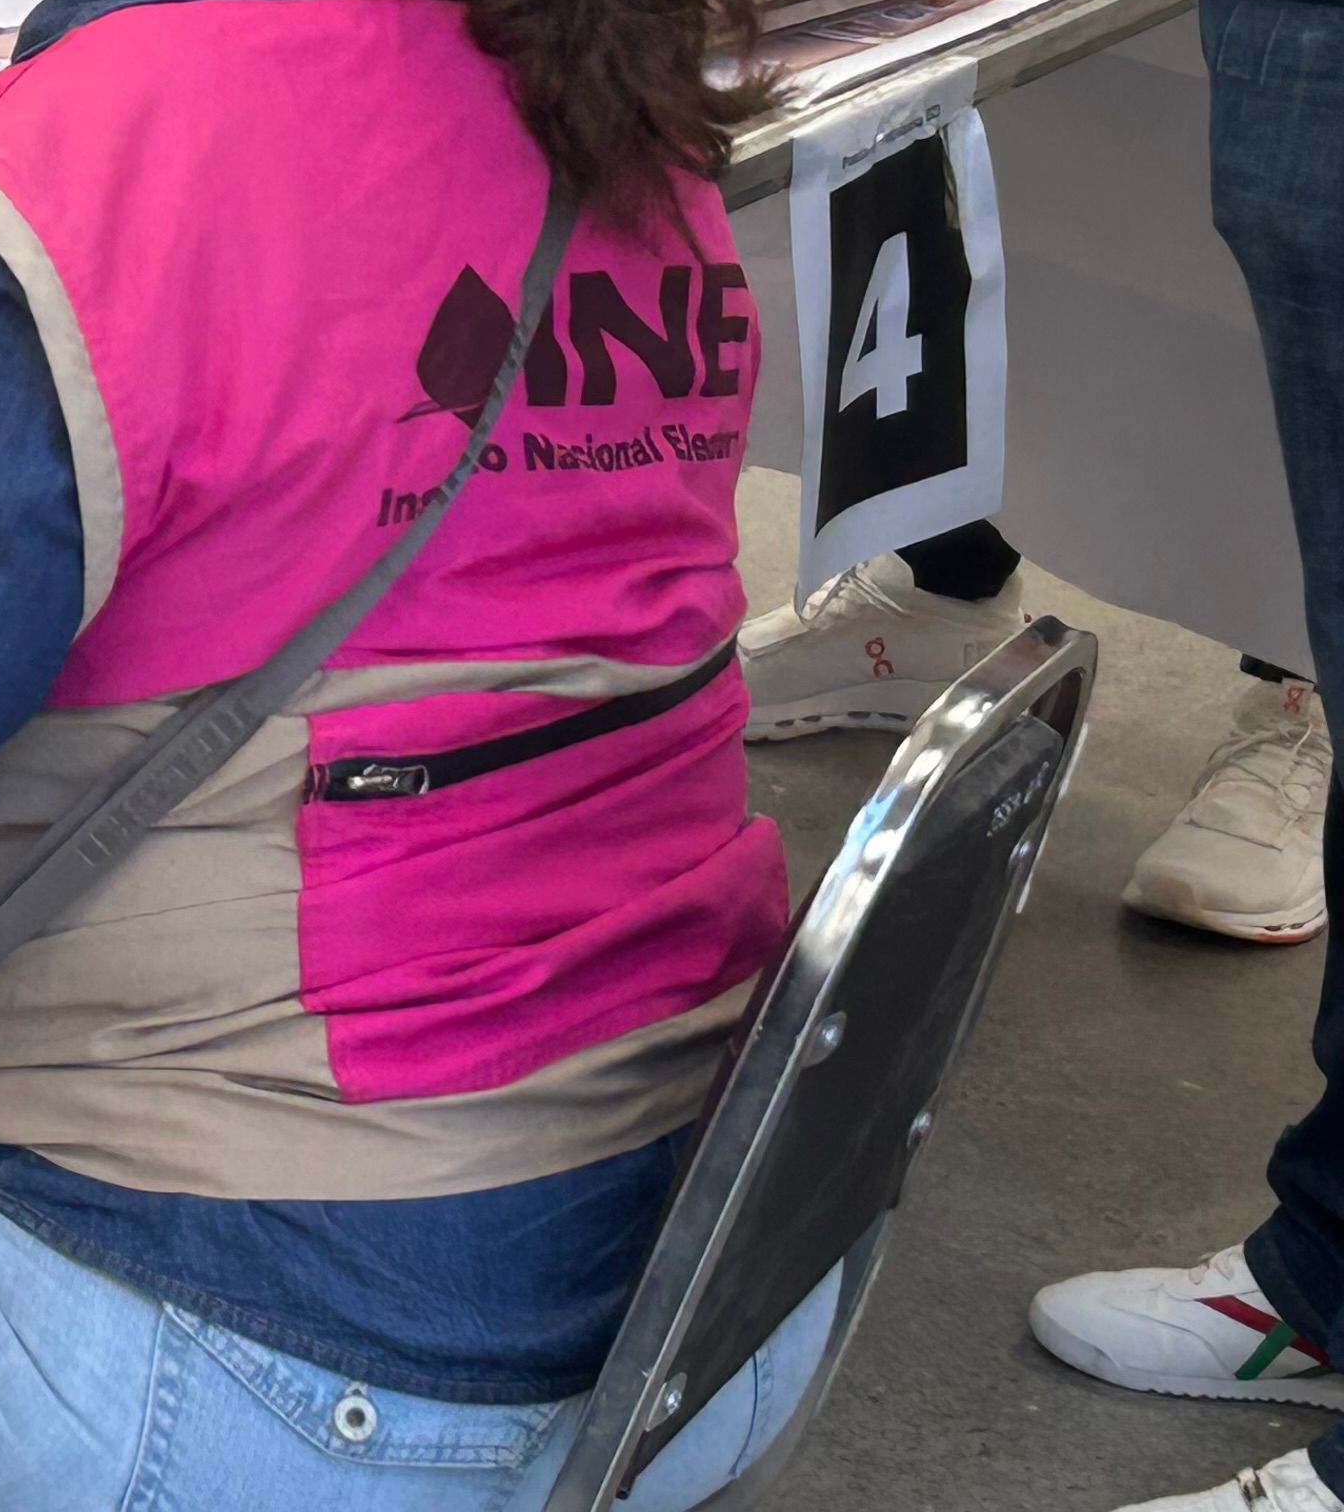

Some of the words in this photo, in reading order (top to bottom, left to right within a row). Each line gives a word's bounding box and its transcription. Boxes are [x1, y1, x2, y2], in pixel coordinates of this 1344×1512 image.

[523, 263, 751, 407] INE
[839, 231, 923, 420] 4
[523, 425, 663, 472] Nacional
